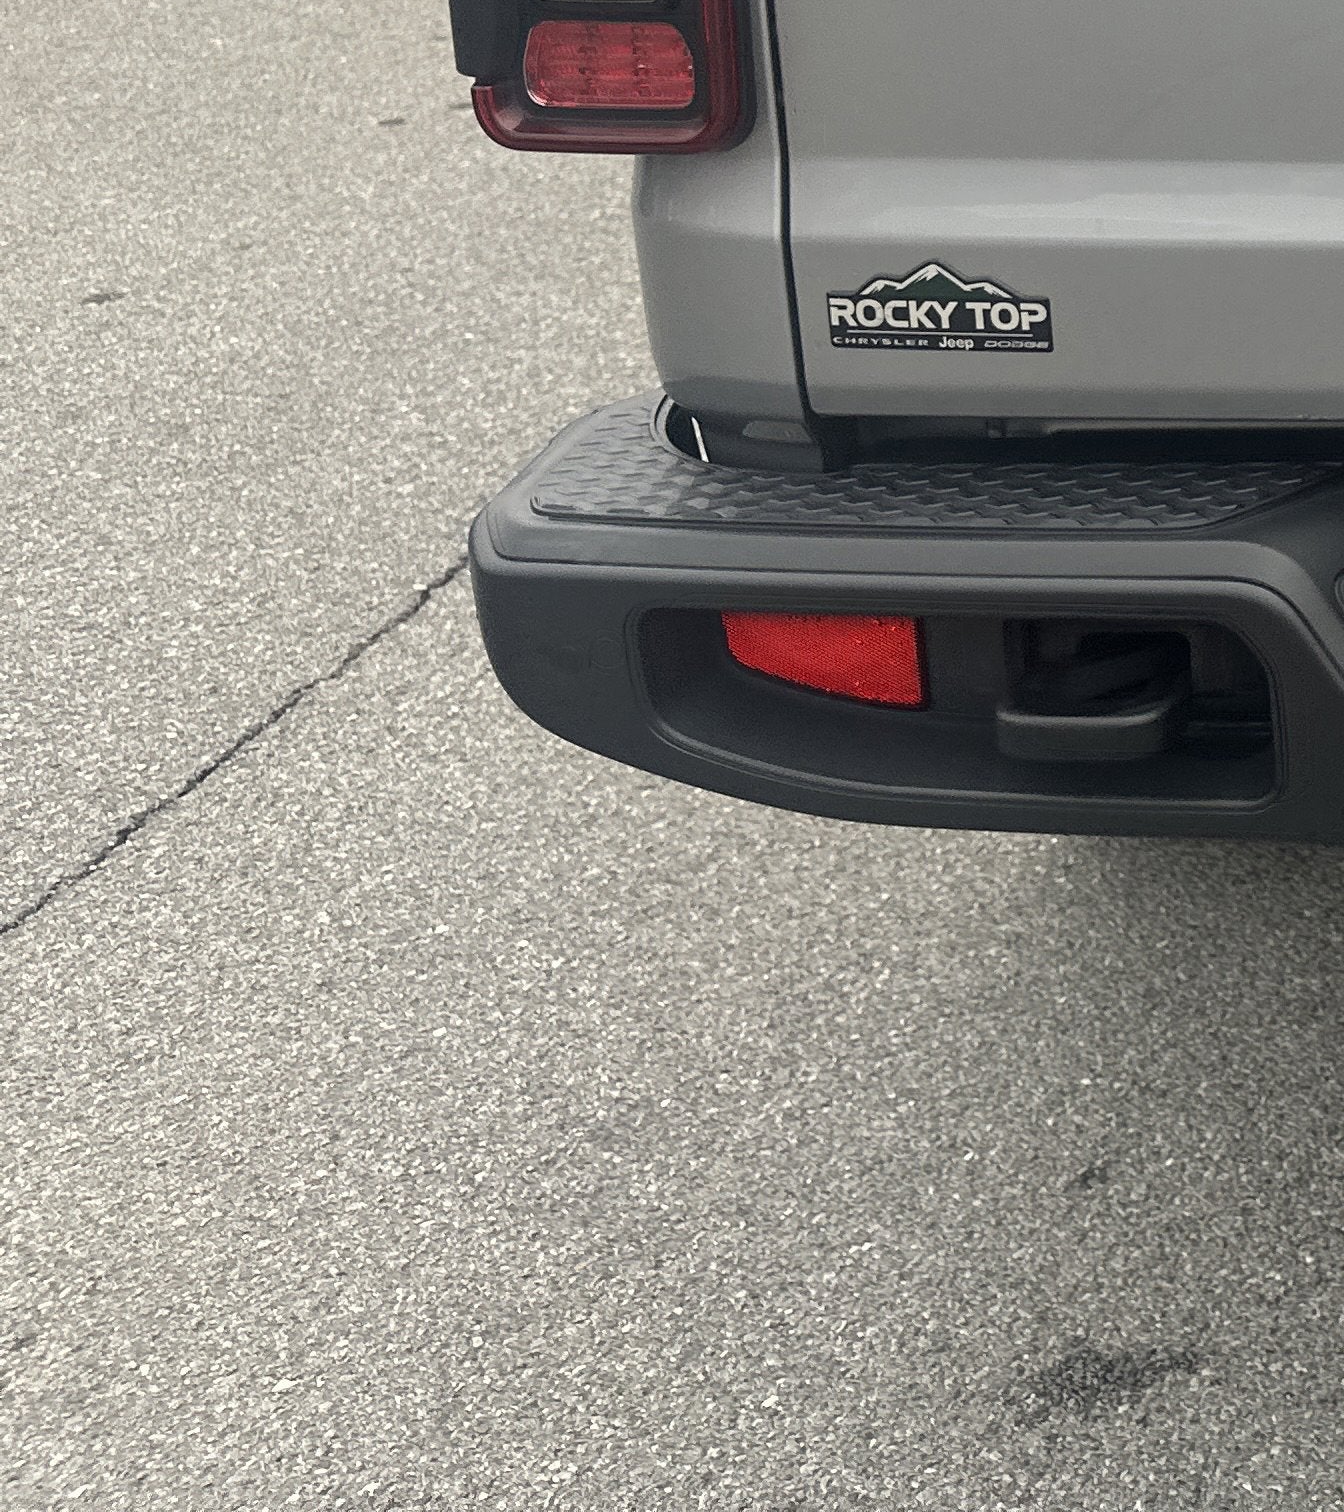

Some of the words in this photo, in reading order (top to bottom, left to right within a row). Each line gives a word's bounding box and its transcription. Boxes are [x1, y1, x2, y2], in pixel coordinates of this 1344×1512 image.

[828, 297, 959, 329] ROCKY
[965, 302, 1048, 331] TOP
[832, 336, 929, 346] CHRYSLER
[938, 335, 975, 351] Jeep
[984, 340, 1049, 349] DODGE
